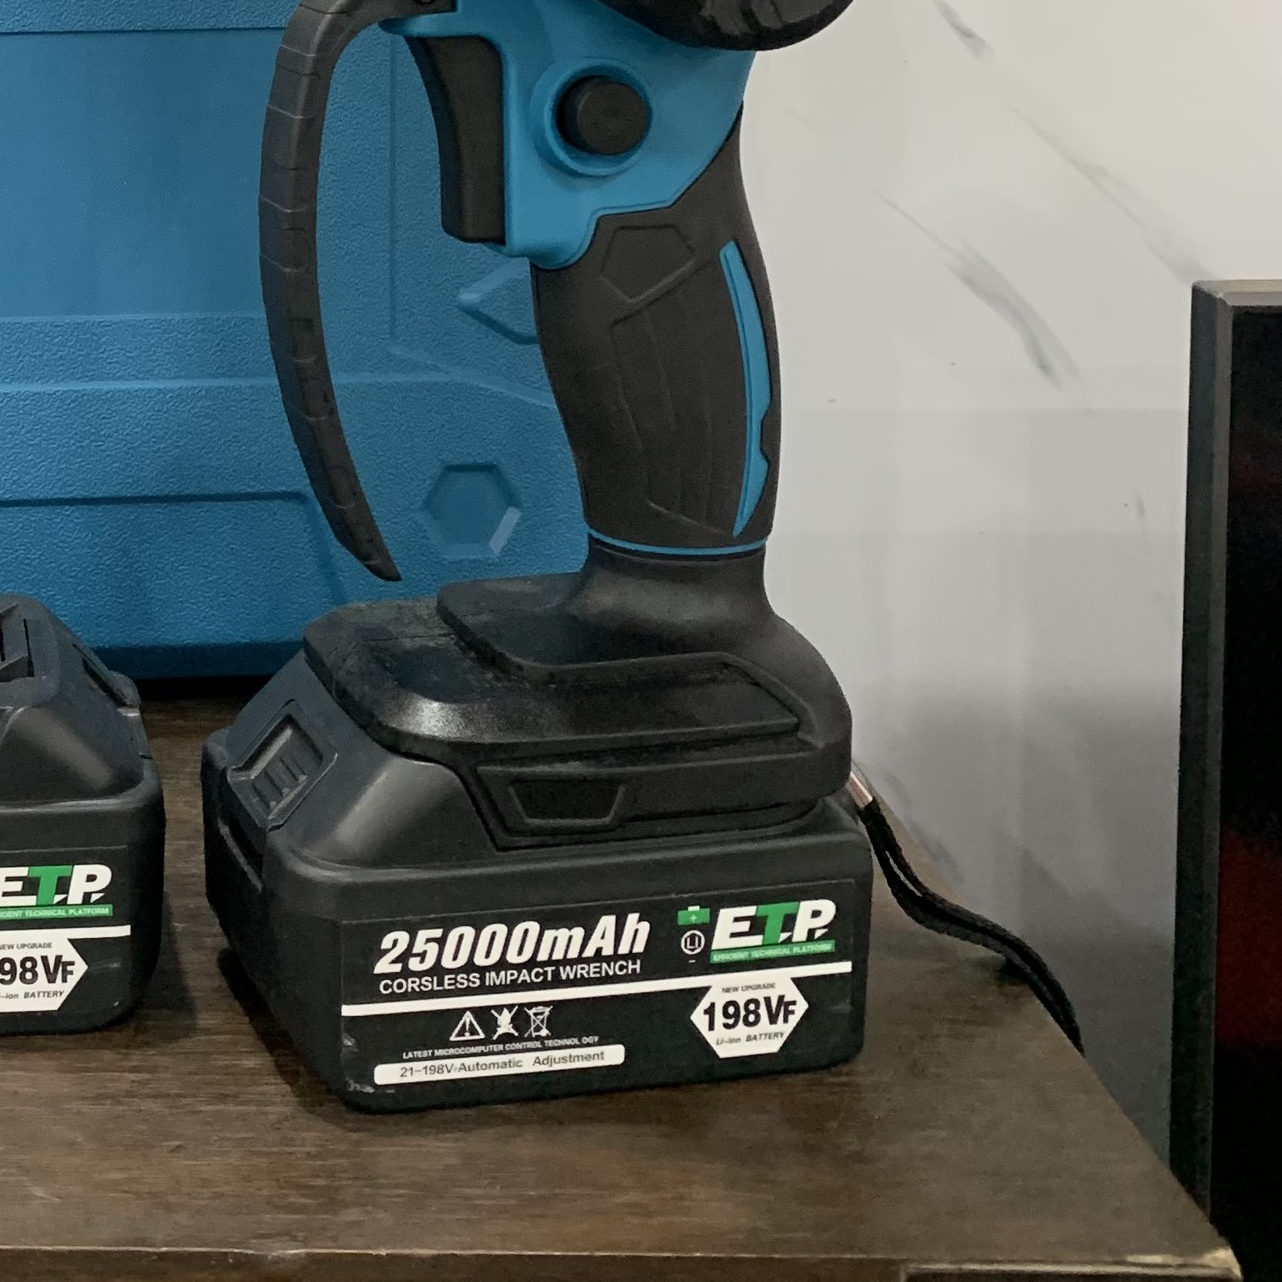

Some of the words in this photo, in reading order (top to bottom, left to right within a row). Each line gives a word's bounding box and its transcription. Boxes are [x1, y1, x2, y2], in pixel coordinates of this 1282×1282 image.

[25, 909, 67, 917] TECHNICAL
[68, 907, 109, 916] PLATFORM
[16, 942, 53, 950] UPGRADE
[373, 912, 651, 974] 25000mAh
[379, 973, 480, 994] CORSLESS
[485, 966, 555, 986] IMPACT
[559, 959, 641, 980] WRENCH
[721, 986, 740, 994] NEW
[741, 982, 776, 992] UPGRADE
[23, 990, 65, 999] BATTERY
[745, 1032, 785, 1042] BATTERY
[402, 1050, 433, 1060] LATEST
[433, 1044, 504, 1057] MICROCOMPUTER
[504, 1041, 543, 1052] CONTROL
[532, 1051, 605, 1068] Adjustment
